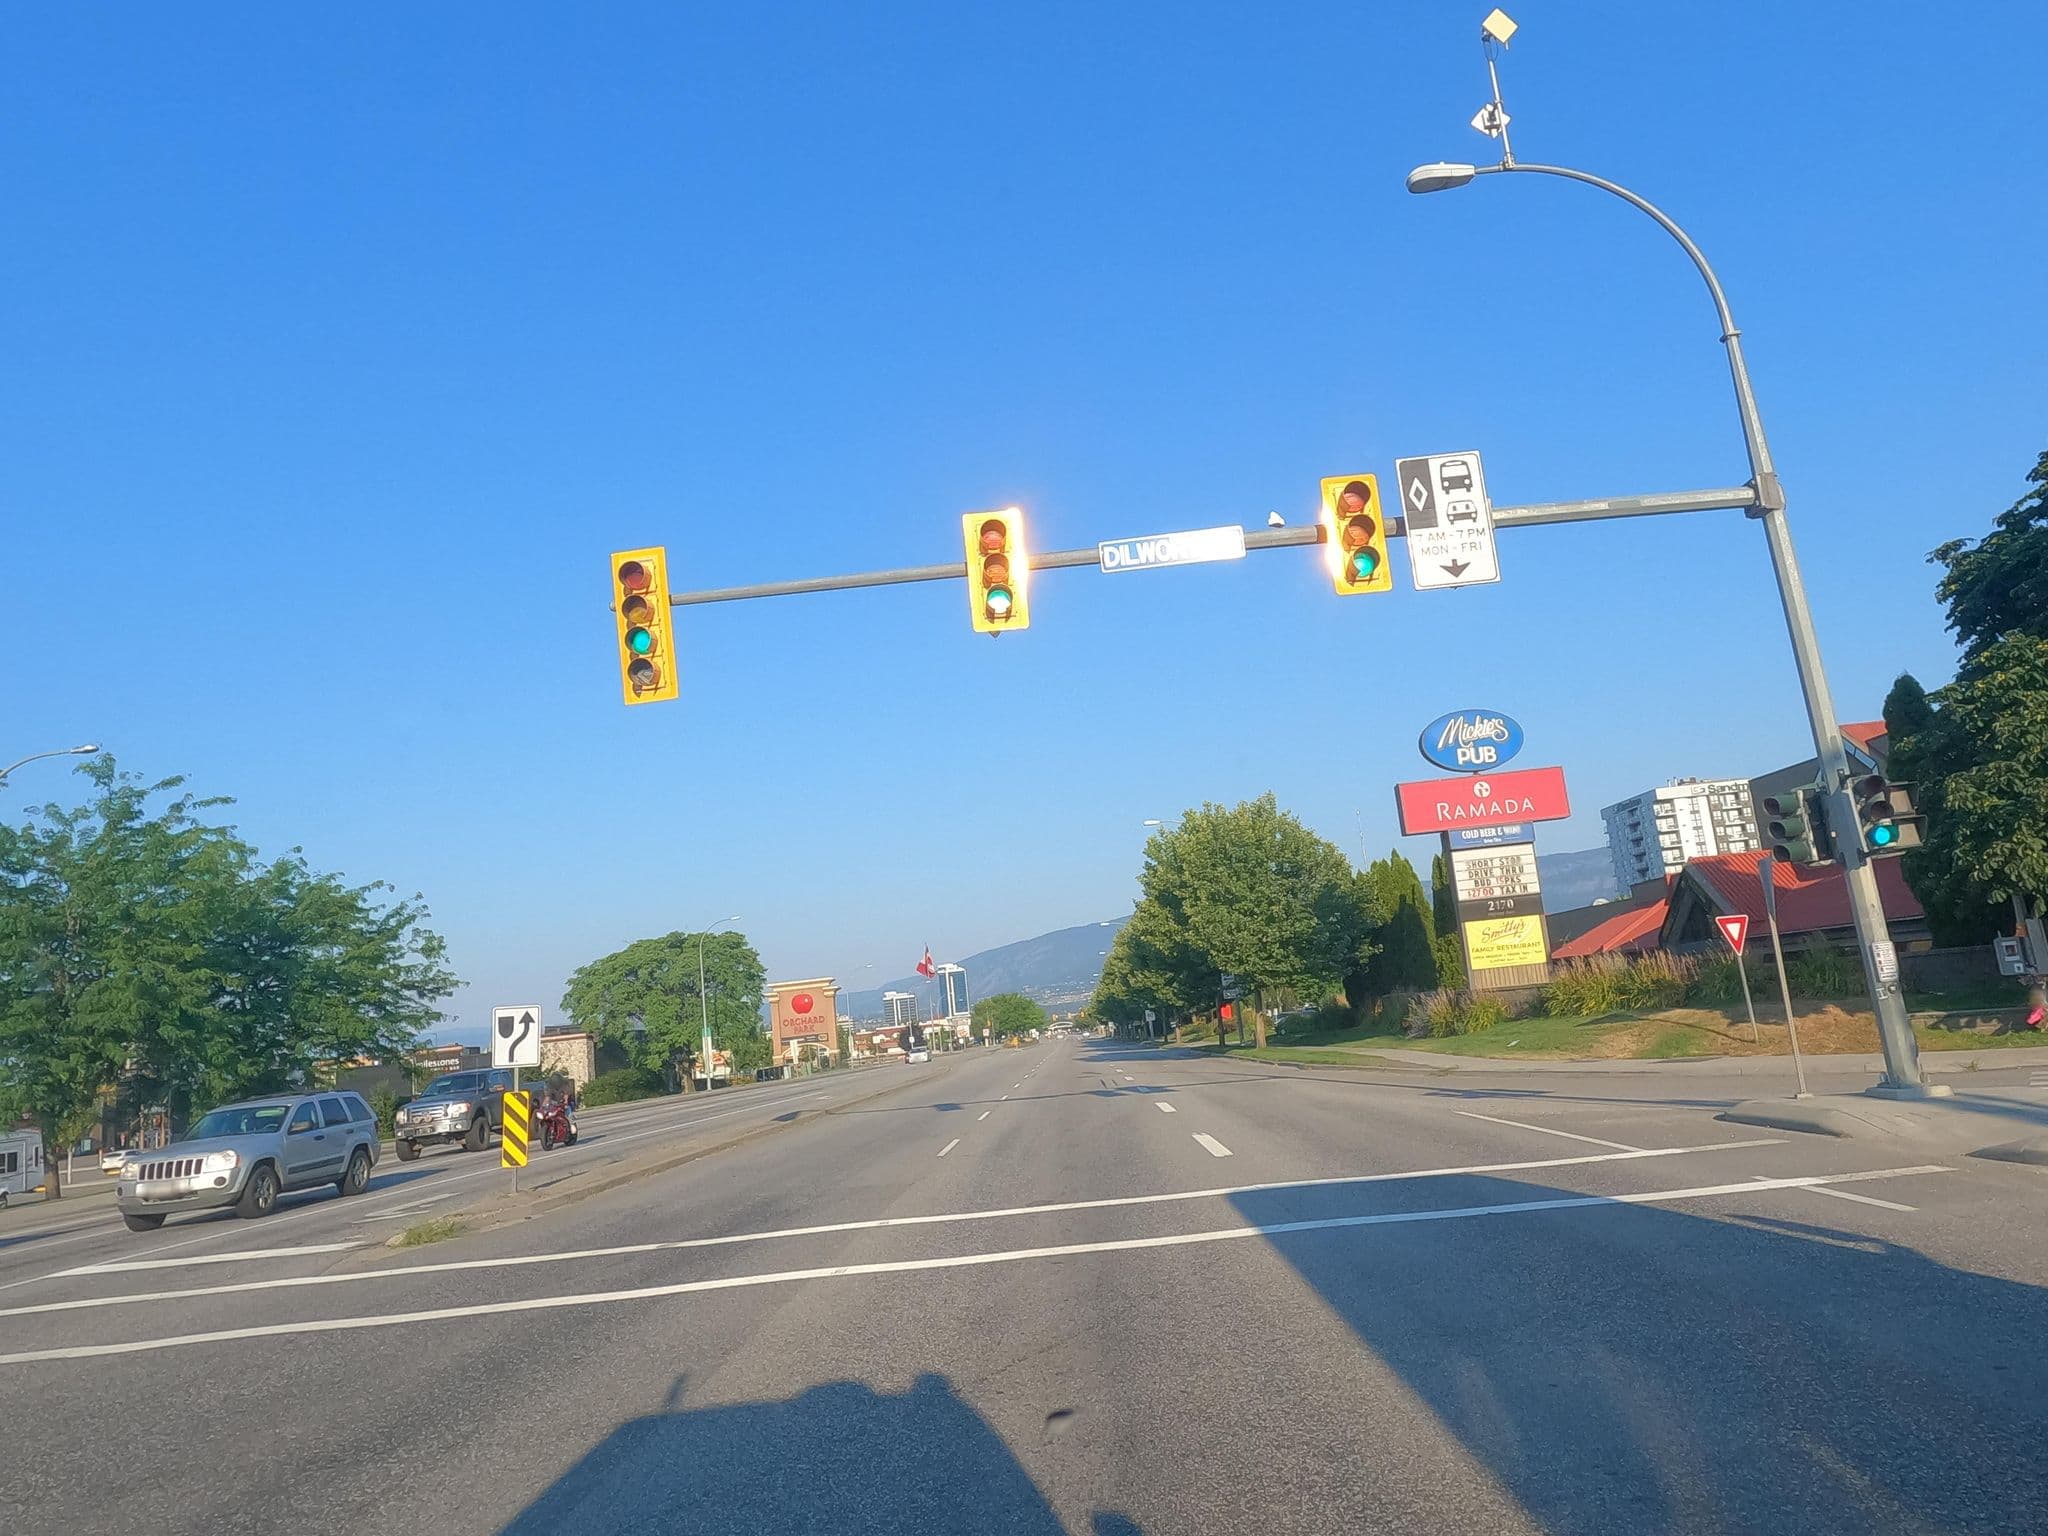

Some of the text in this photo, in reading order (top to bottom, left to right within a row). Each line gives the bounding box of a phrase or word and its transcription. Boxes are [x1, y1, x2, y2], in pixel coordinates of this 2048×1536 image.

[1428, 531, 1446, 541] AM
[1456, 529, 1464, 539] 7
[1467, 527, 1486, 538] PM
[1421, 544, 1449, 557] MON
[1460, 541, 1482, 553] FRI
[1456, 746, 1498, 765] PUB
[1436, 798, 1535, 821] RAMADA
[1461, 829, 1480, 840] COLD
[1480, 827, 1497, 838] BEER
[1468, 864, 1524, 879] DRIVE THRU
[1474, 878, 1491, 888] BUD
[1500, 884, 1517, 895] TAX
[1519, 882, 1529, 893] IN
[1487, 899, 1514, 911] 2170
[783, 1016, 825, 1027] ORCHARD
[793, 1024, 815, 1034] PARK
